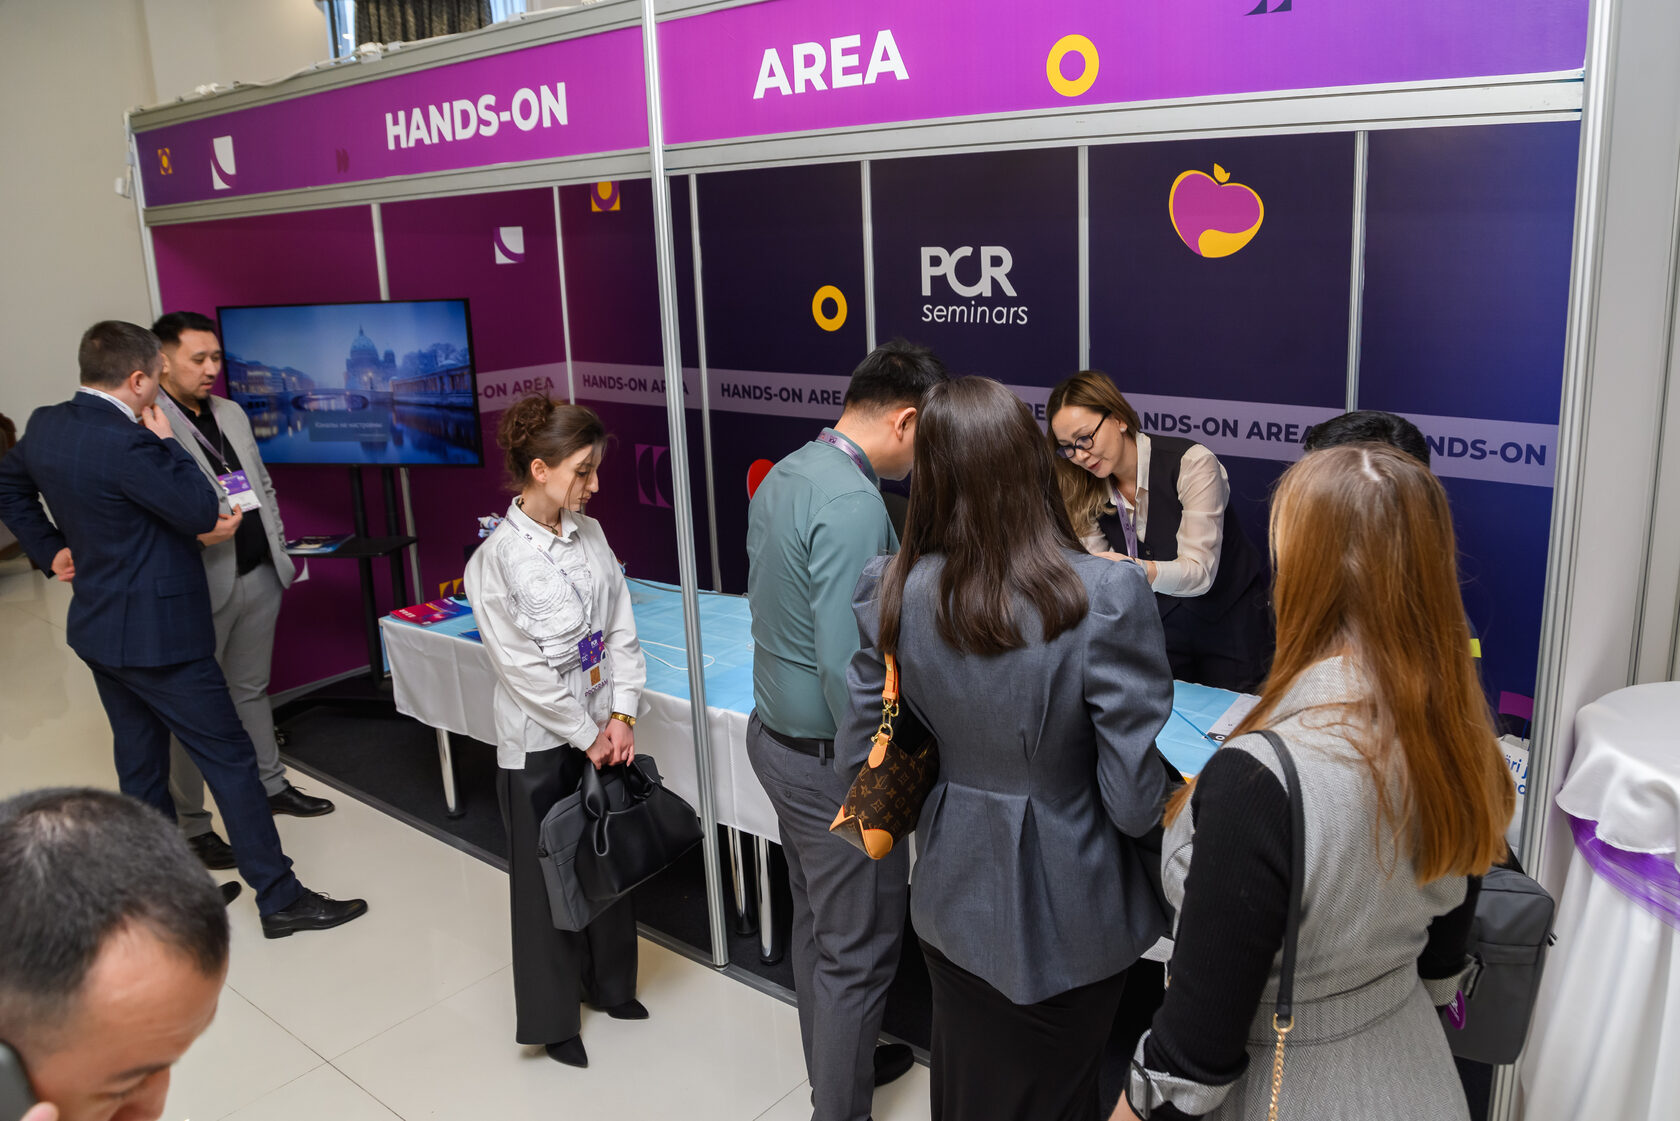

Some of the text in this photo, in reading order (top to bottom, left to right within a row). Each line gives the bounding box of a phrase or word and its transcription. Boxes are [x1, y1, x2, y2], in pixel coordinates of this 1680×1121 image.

[385, 29, 910, 151] HANDS-ON AREA
[920, 245, 1018, 298] PCR
[921, 300, 1029, 325] seminars
[512, 376, 555, 395] AREA
[582, 373, 648, 392] HANDS-ON
[720, 382, 847, 407] HANDS-ON ARE
[1138, 410, 1239, 438] NDS-ON
